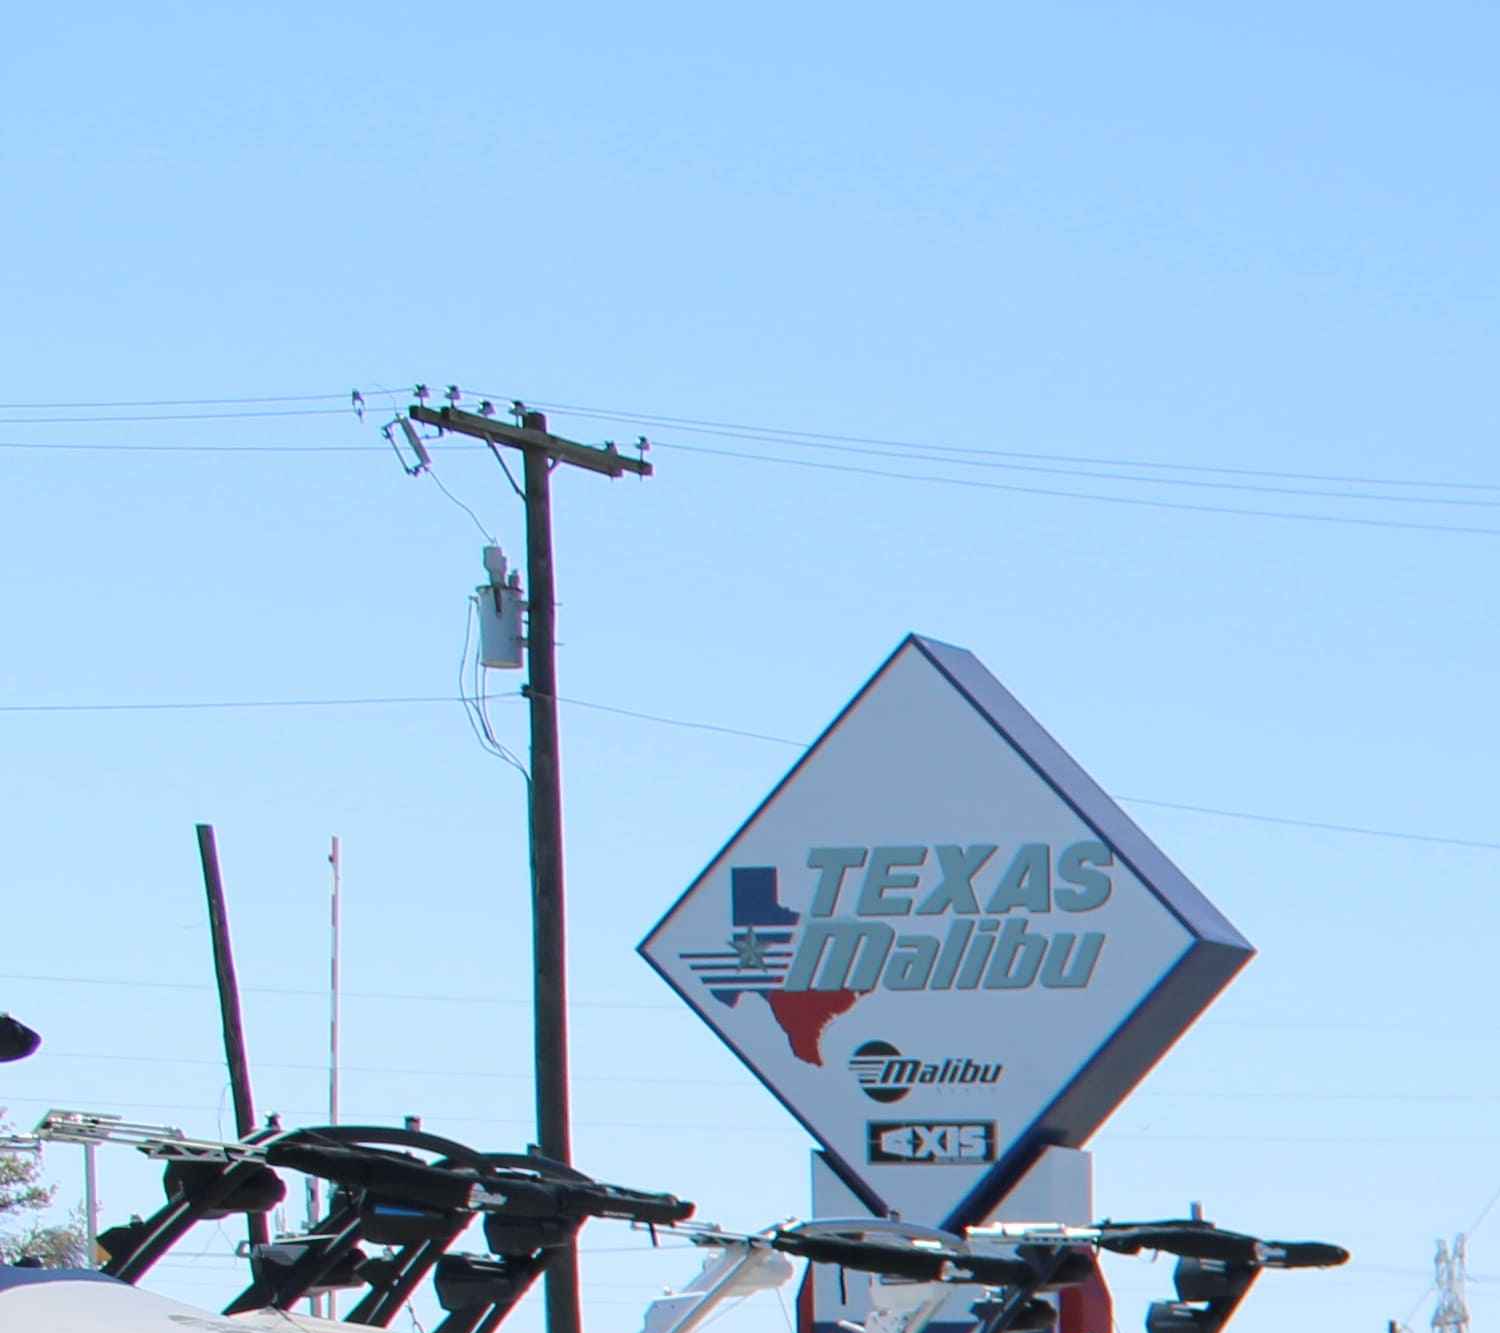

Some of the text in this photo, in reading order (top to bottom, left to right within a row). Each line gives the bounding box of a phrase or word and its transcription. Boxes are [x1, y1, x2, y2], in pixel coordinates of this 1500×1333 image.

[806, 840, 1114, 919] TEXAS
[784, 918, 1105, 993] Malibu
[880, 1058, 1003, 1084] Malibu
[881, 1124, 987, 1160] AXIS
